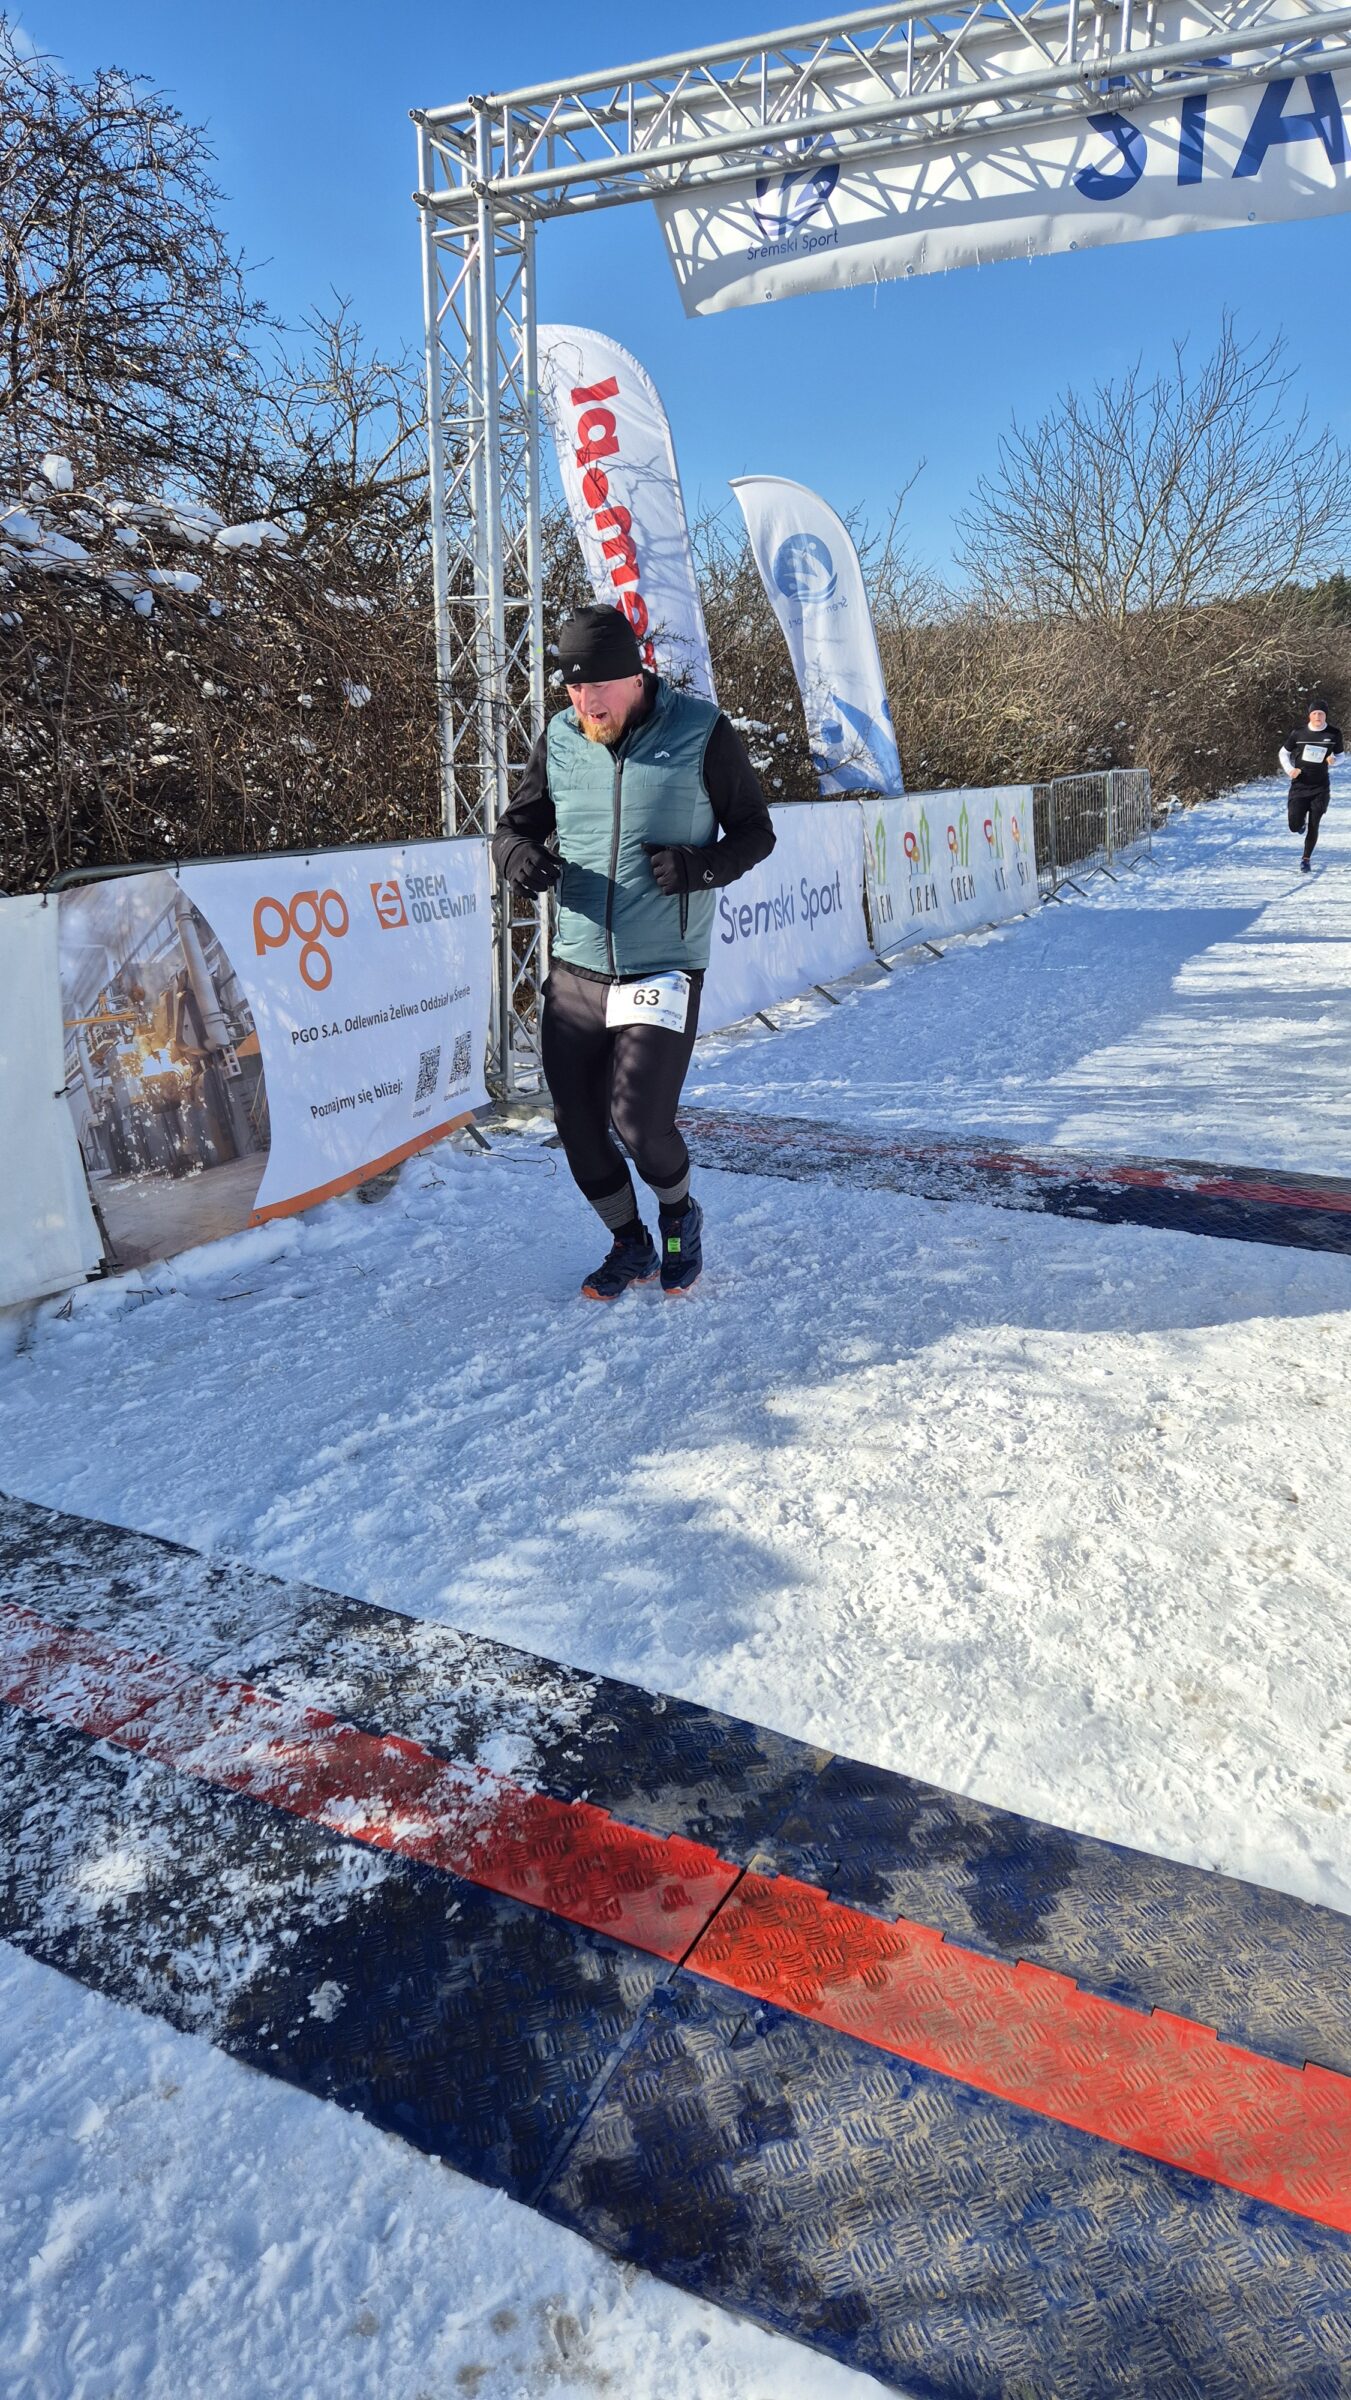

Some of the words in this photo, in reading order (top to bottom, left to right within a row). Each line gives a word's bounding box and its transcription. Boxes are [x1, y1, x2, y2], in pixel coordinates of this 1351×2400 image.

[747, 238, 798, 260] Śremski
[801, 229, 839, 252] Sport
[405, 873, 448, 900] ŚREM
[719, 883, 795, 944] Śremski
[801, 870, 843, 932] Sport
[633, 989, 661, 1006] 63
[291, 1027, 319, 1045] PGO
[322, 1024, 343, 1039] S.A.
[344, 1010, 389, 1032] Odlewnia
[390, 1003, 419, 1021] Żeliwa
[310, 1096, 355, 1119] Poznajmy
[358, 1088, 374, 1104] się
[373, 1078, 404, 1099] bliżej:
